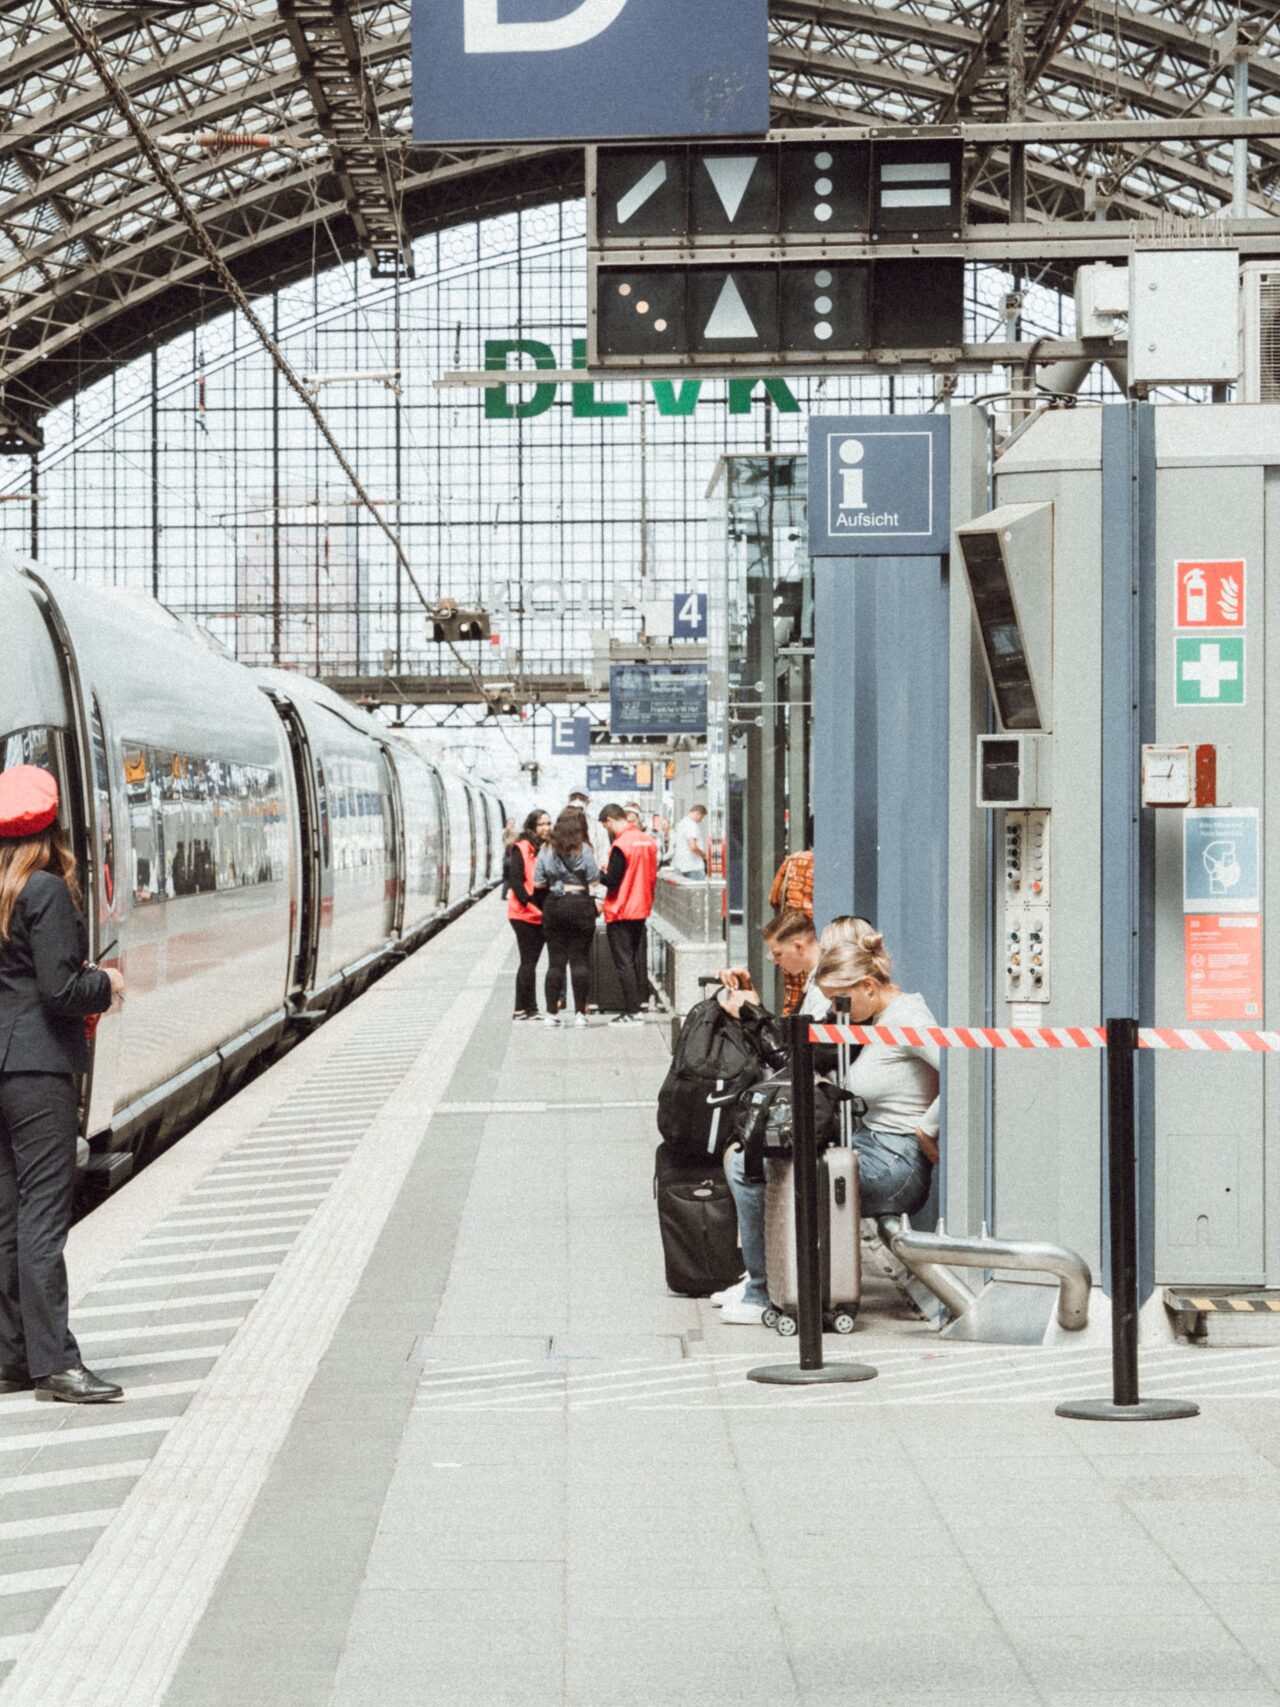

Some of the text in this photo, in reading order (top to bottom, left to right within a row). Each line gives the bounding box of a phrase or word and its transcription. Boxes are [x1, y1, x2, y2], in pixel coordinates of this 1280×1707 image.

[835, 512, 899, 527] Aufsicht
[678, 594, 702, 628] 4
[555, 717, 575, 748] E
[601, 766, 613, 785] F
